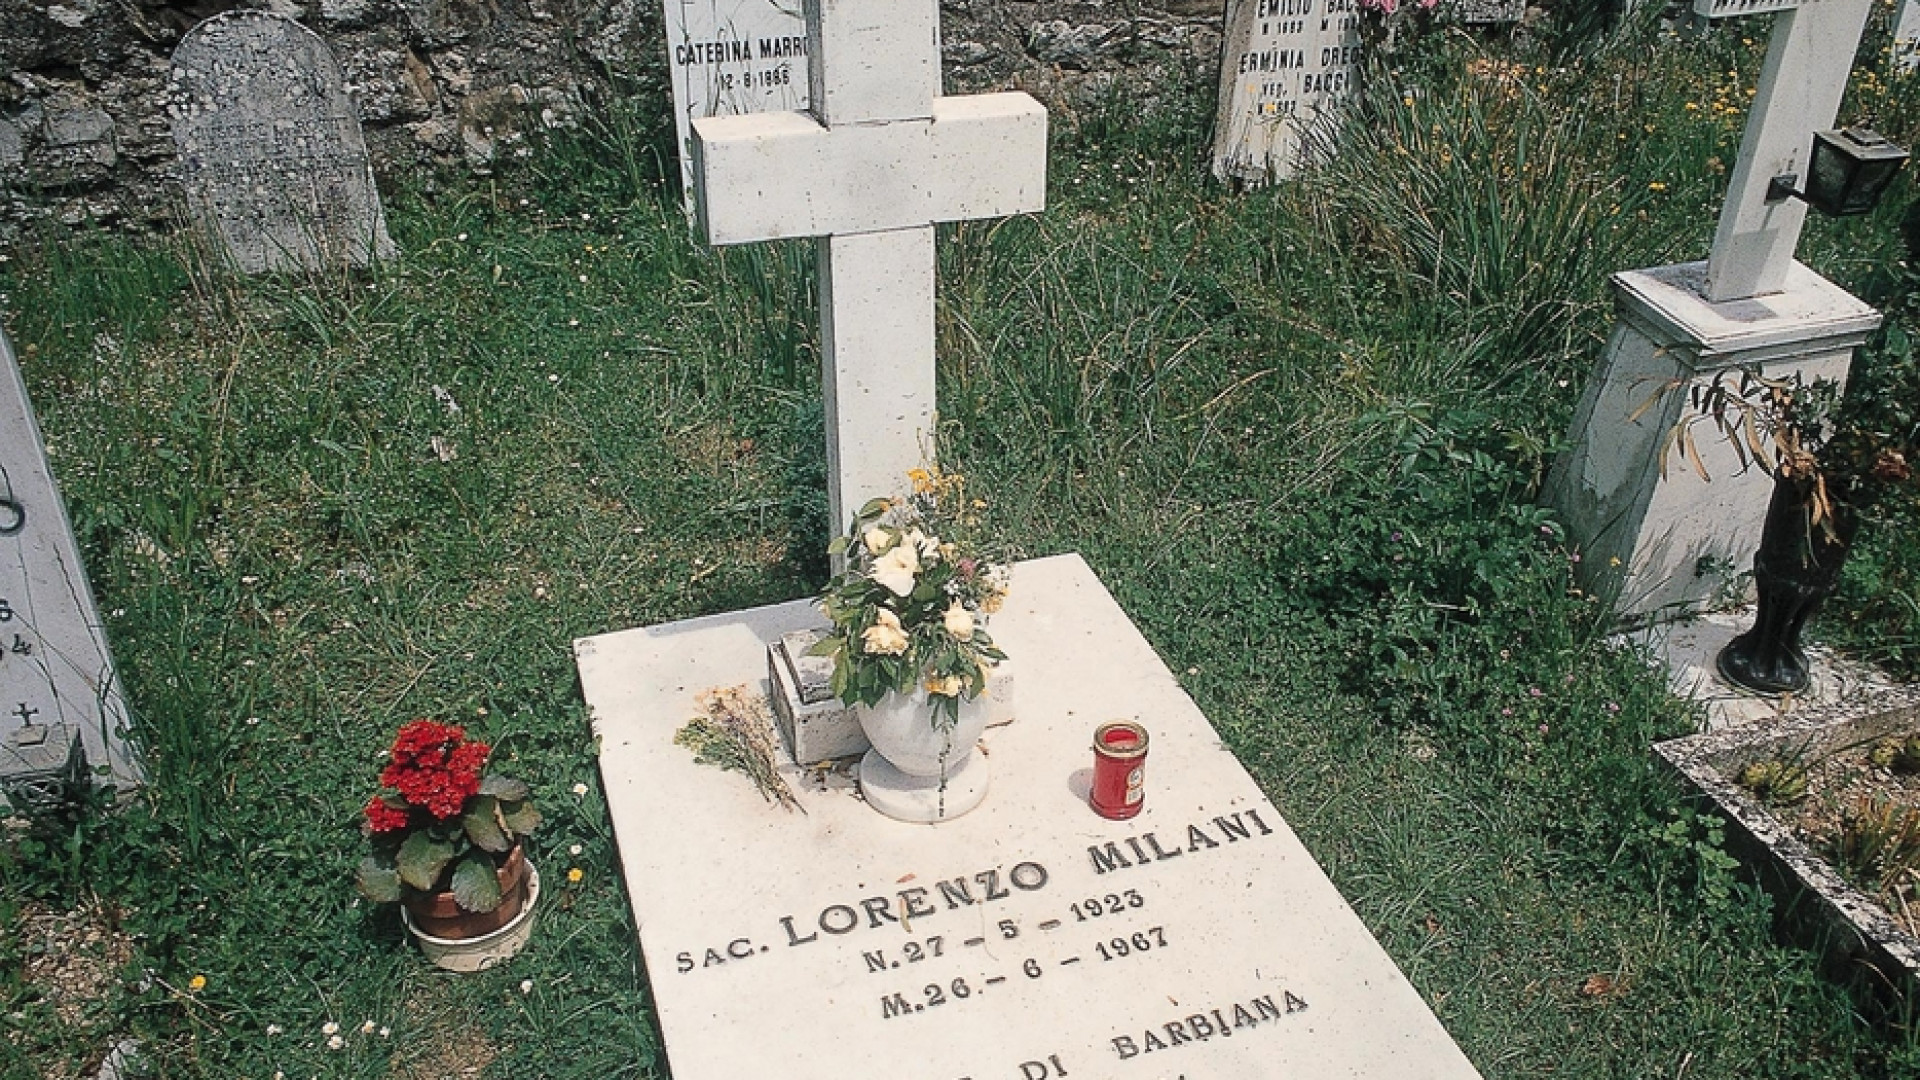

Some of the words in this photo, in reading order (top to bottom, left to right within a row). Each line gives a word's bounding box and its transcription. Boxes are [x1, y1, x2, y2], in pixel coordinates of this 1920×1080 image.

[675, 40, 752, 65] CATERINA
[1239, 50, 1304, 74] ERMINIA
[675, 937, 770, 974] SAC.
[778, 861, 1050, 948] LORENZO
[1086, 808, 1275, 875] MILANI
[997, 919, 1020, 940] 5
[1069, 888, 1145, 923] 1923
[1022, 957, 1043, 980] 6
[1095, 925, 1169, 962] 1967
[1018, 1054, 1069, 1080] DI
[1110, 989, 1310, 1061] BARBIANA
